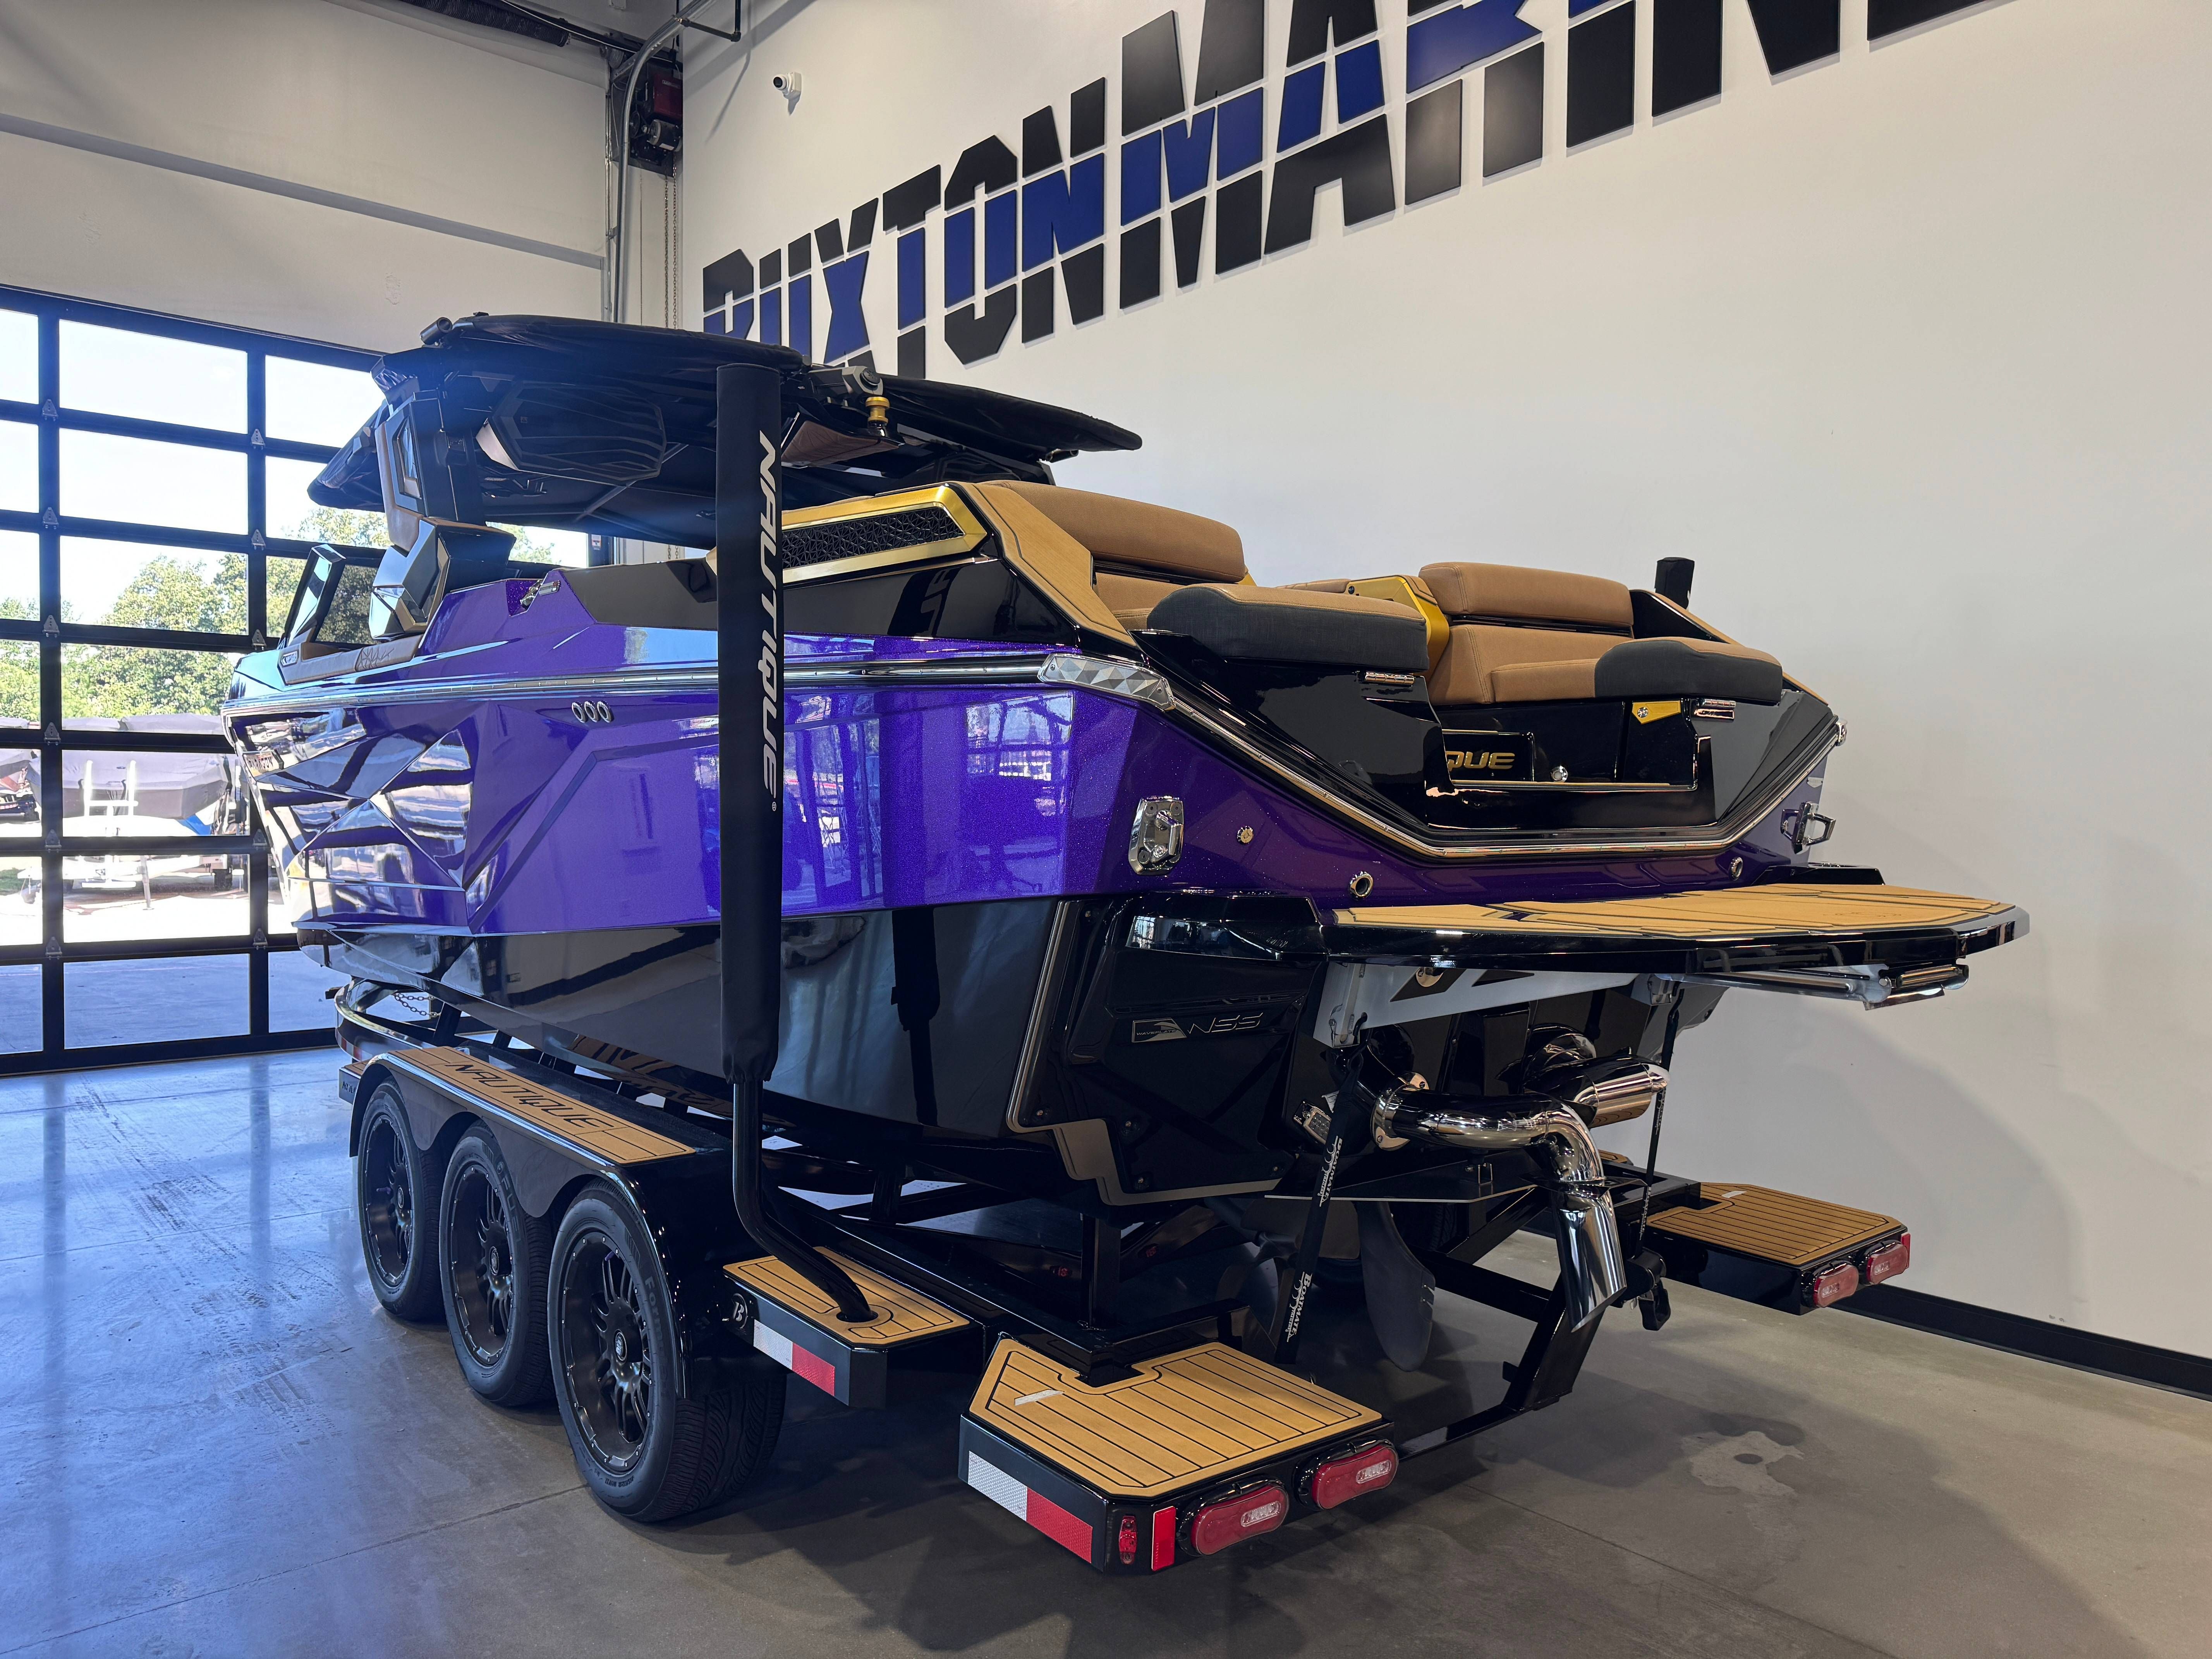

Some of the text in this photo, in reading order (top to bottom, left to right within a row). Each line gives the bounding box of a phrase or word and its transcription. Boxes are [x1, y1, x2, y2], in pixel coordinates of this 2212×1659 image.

[758, 430, 776, 799] NAUTIQUE
[445, 1064, 614, 1128] NAUTIQUE
[1292, 1273, 1313, 1335] BOATMATE
